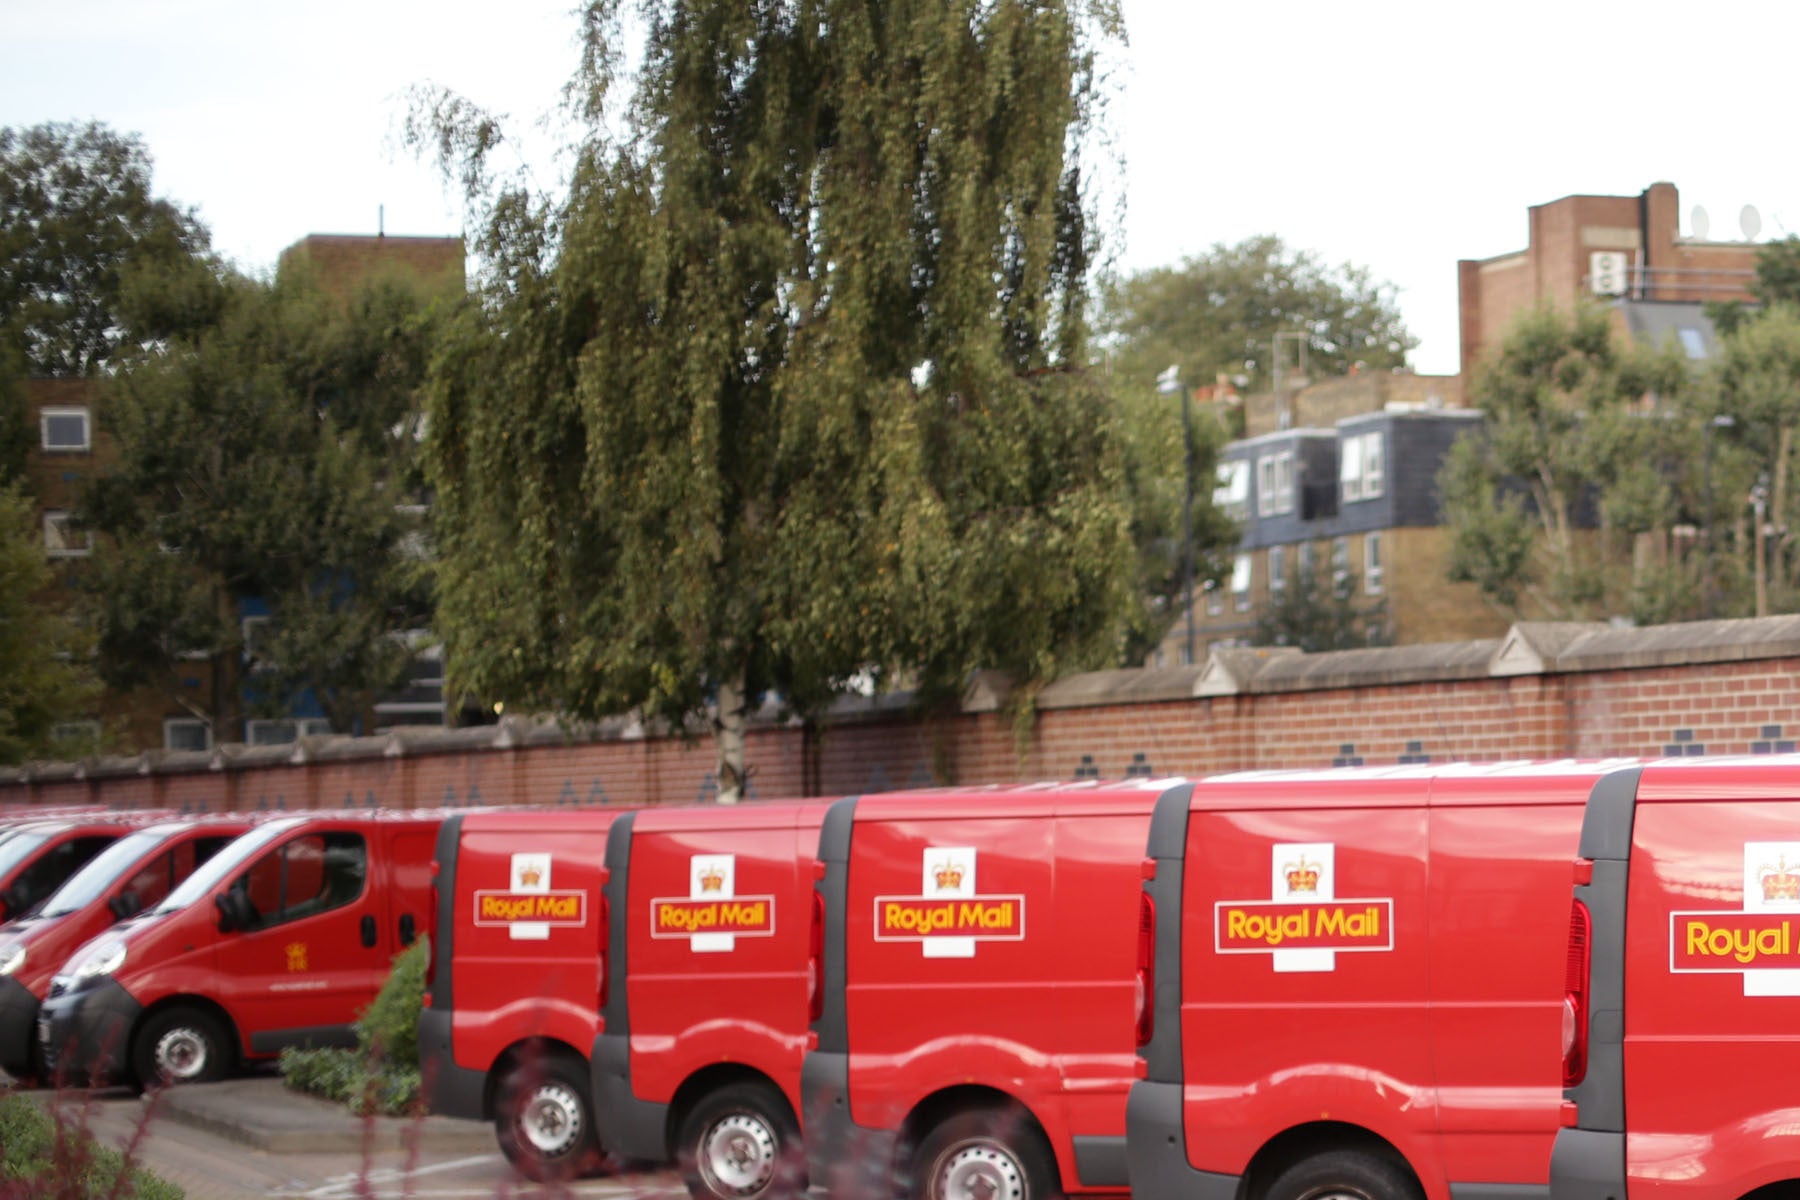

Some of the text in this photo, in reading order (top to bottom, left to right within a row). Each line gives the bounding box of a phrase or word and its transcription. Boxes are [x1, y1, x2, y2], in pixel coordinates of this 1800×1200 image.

[482, 896, 578, 919] Royal Mail
[660, 901, 765, 930] Royal Mail
[885, 900, 1013, 934] Royal Mail
[1227, 906, 1380, 945] Royal Mail
[1686, 920, 1792, 963] Royal
